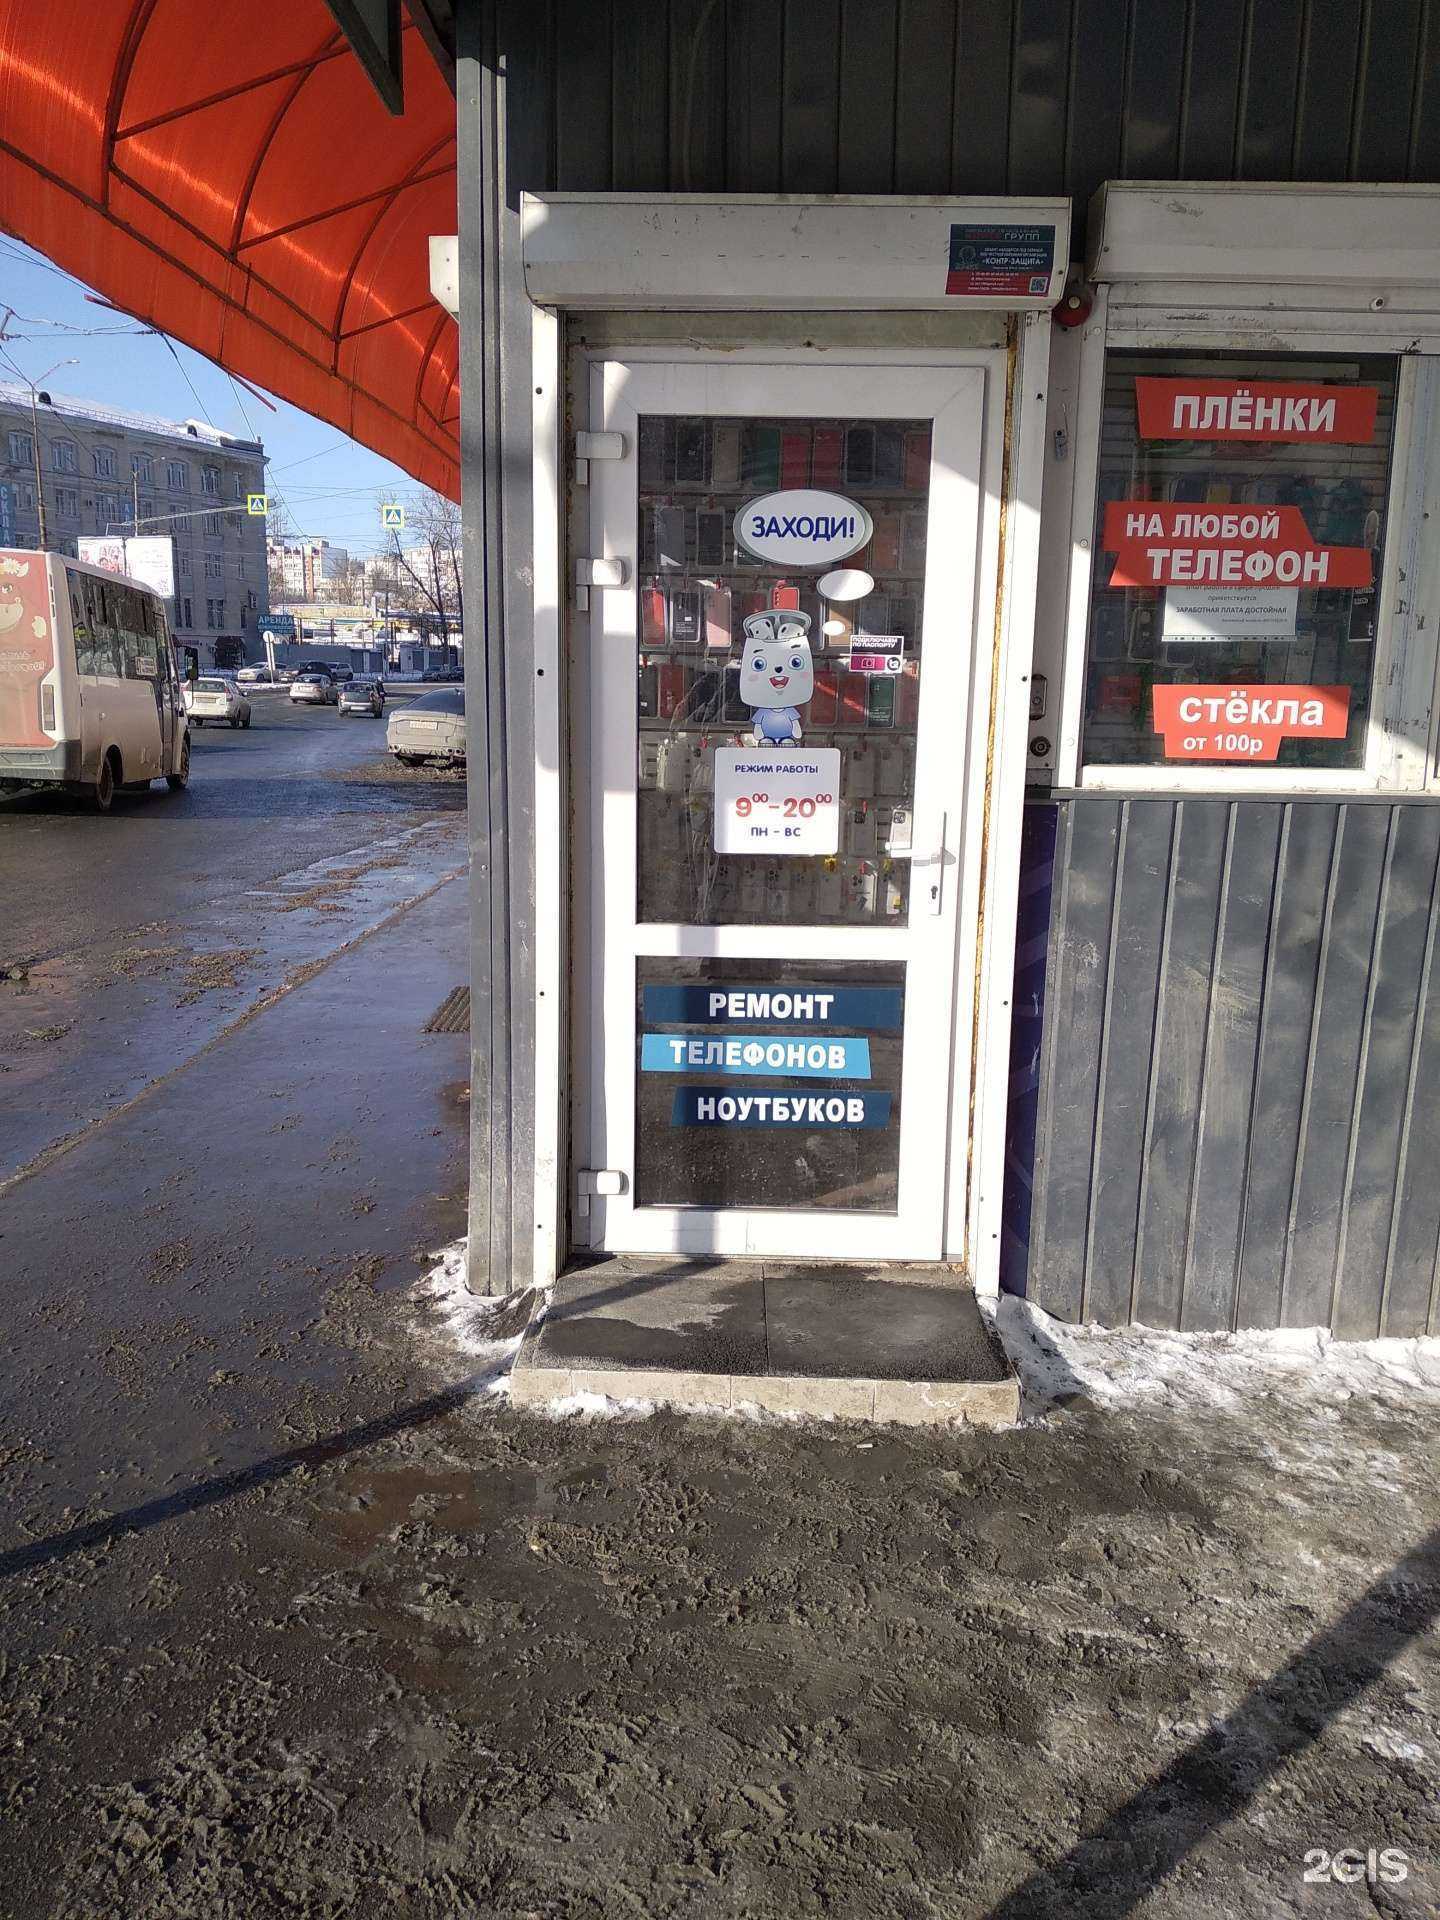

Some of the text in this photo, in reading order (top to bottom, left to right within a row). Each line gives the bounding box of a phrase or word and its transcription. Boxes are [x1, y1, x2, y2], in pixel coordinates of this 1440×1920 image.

[1004, 232, 1040, 241] ГРУПП
[1172, 389, 1337, 432] ПЛЁНКИ
[751, 516, 855, 542] ЗАХОДИ!
[1126, 510, 1280, 539] НА ЛЮБОЙ
[1146, 548, 1330, 582] ТЕЛЕФОН
[258, 616, 294, 625] АРЕНДА
[1245, 606, 1287, 614] ДОСТОЙНАЯ
[1178, 690, 1325, 726] стёкла
[1183, 734, 1263, 755] от 100р
[734, 764, 819, 774] РЕЖИМ РАБОТЫ
[751, 827, 769, 837] ПН
[784, 827, 801, 837] ВС
[708, 993, 835, 1020] РЕМОНТ
[669, 1040, 847, 1070] ТЕЛЕФОНОВ
[697, 1097, 865, 1123] НОУТБУКОВ
